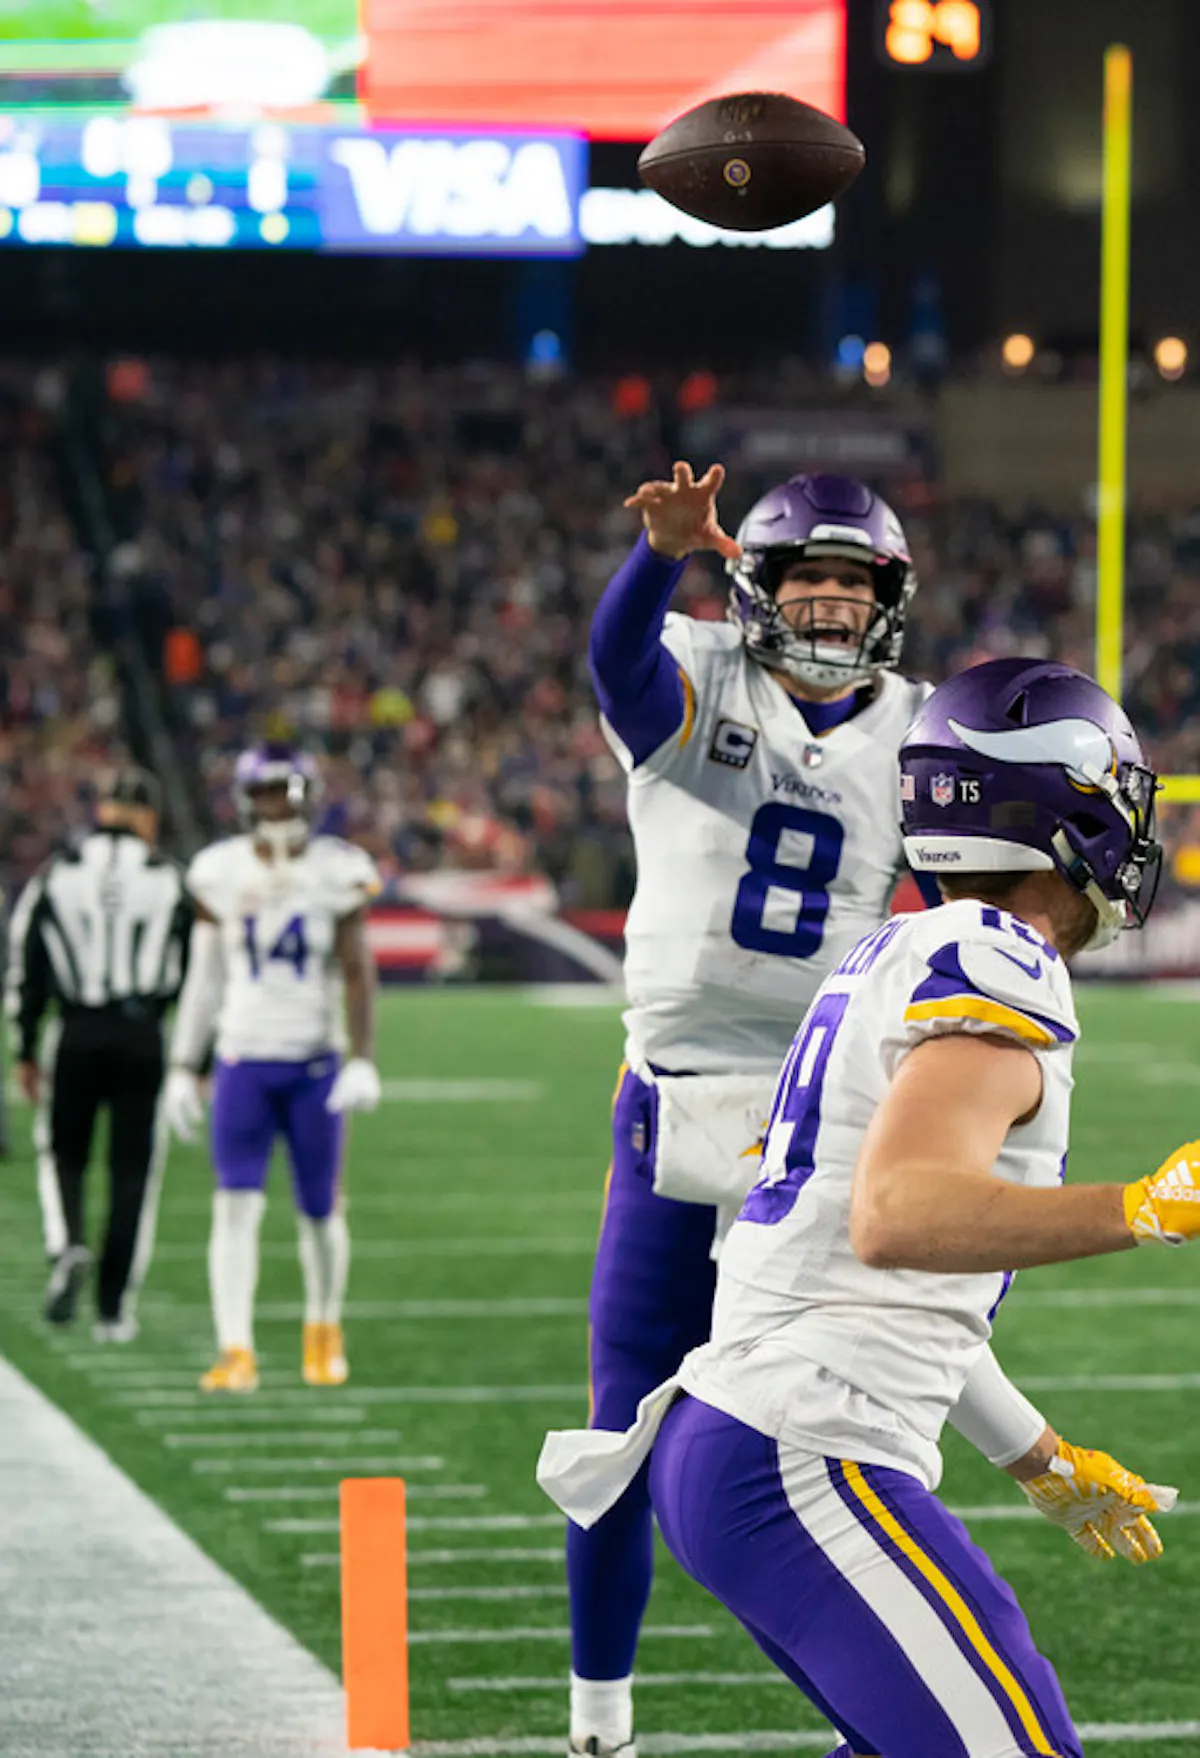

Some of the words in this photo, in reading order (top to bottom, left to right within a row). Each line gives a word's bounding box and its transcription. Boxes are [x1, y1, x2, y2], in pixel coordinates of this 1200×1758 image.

[330, 138, 573, 238] VISA
[715, 721, 757, 758] C
[960, 780, 981, 803] TS
[730, 801, 846, 959] 8
[240, 914, 310, 981] 14
